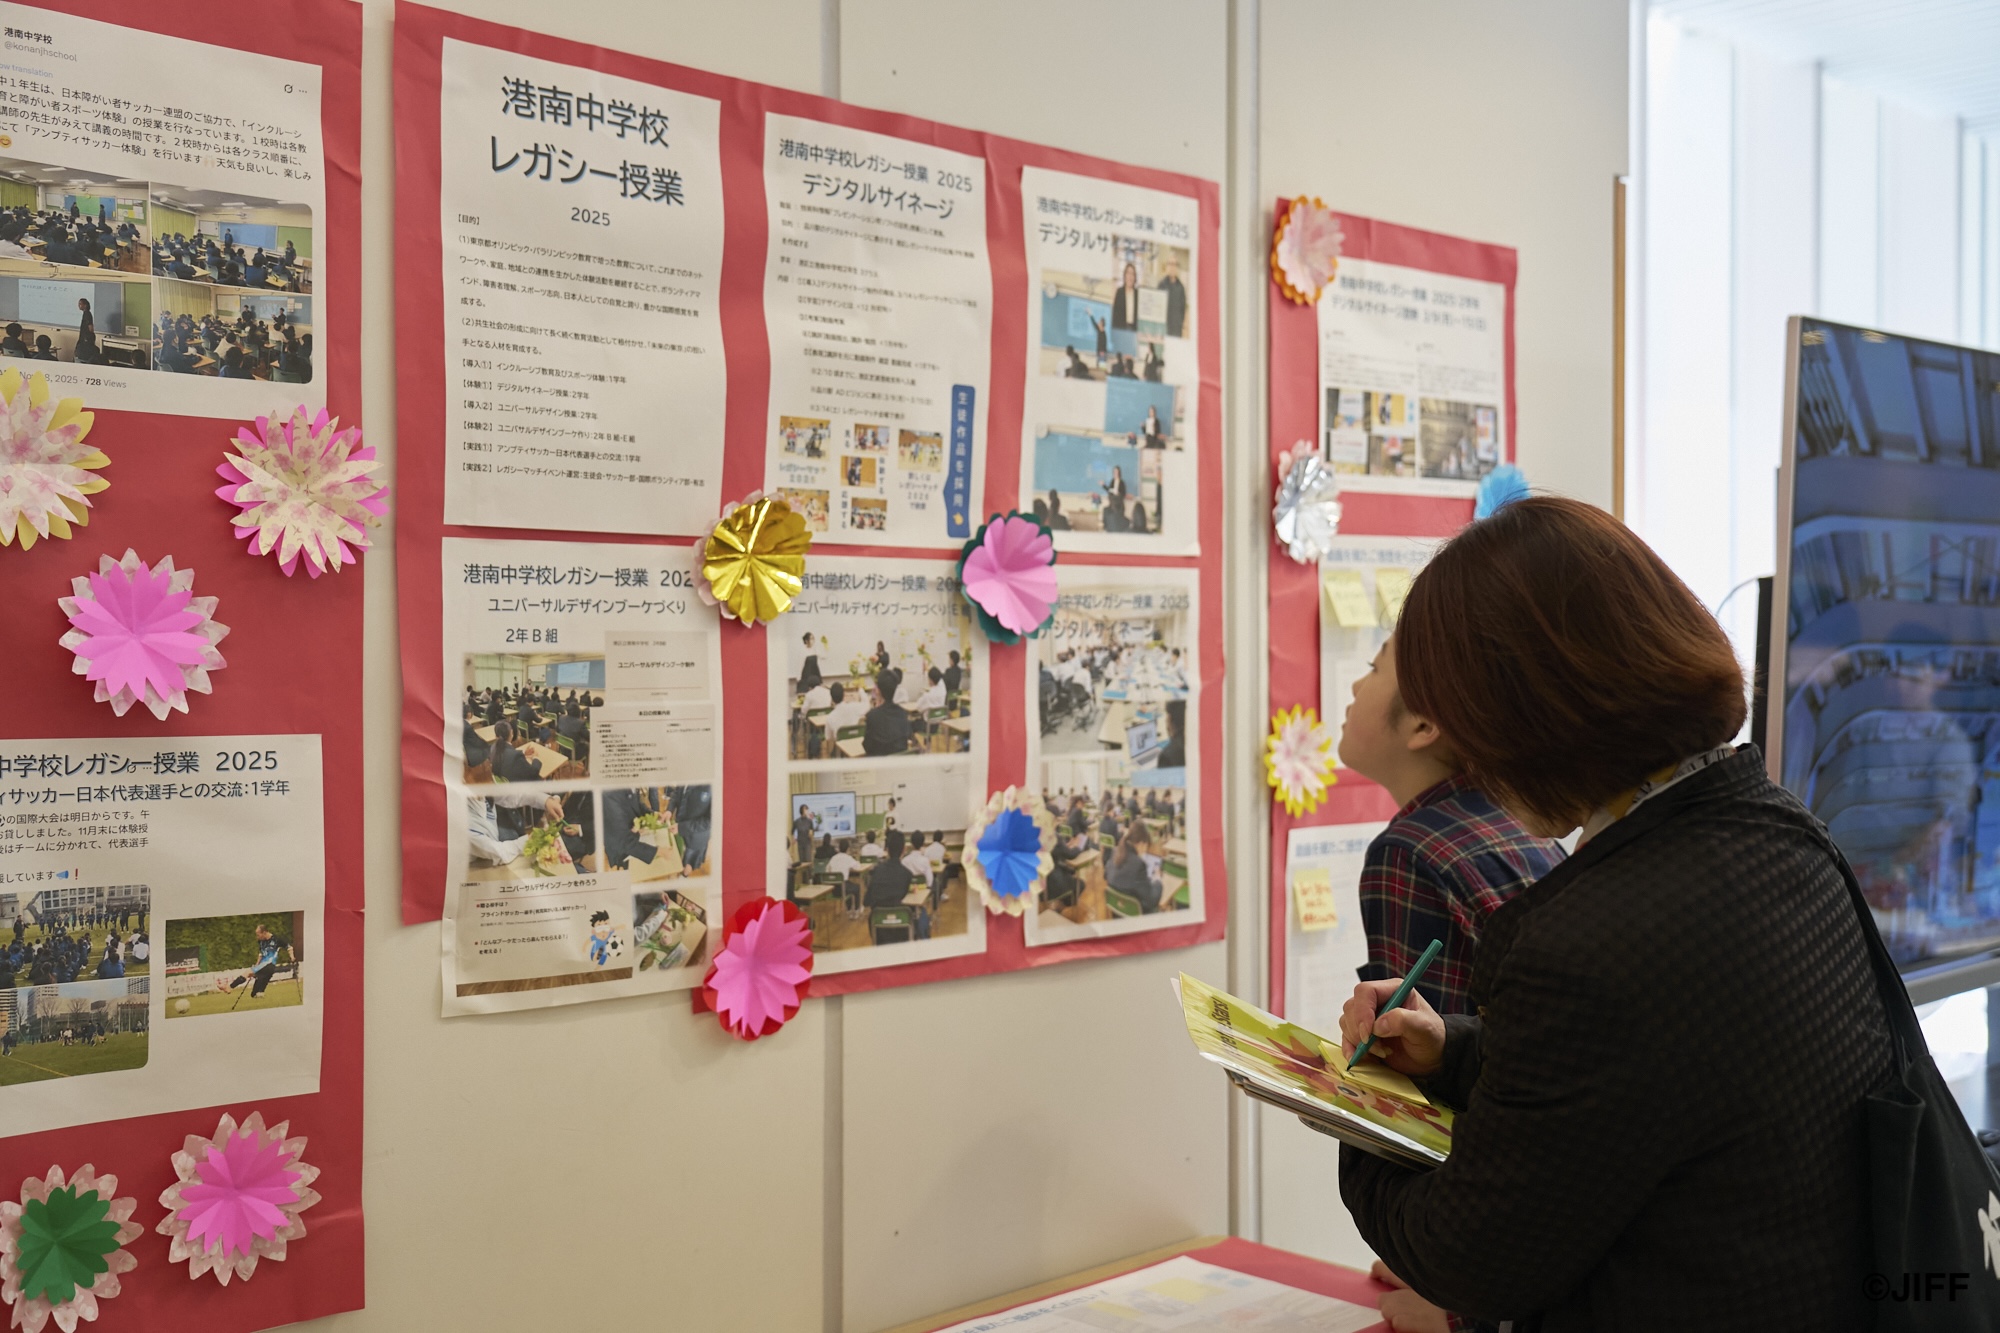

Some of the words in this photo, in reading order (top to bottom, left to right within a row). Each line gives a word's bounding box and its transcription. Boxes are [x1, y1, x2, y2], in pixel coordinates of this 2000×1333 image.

[4, 27, 53, 45] 港南中学校
[4, 40, 78, 62] @konanjhschool
[12, 64, 54, 78] translation
[501, 75, 670, 149] 港南中学校
[490, 135, 685, 207] レガシー授業
[779, 138, 929, 184] 港南中学校レガシー授業
[937, 170, 973, 193] 2025
[802, 173, 955, 220] デジタルサイネージ
[458, 213, 480, 225] 【目的】
[570, 207, 611, 226] 2025
[1037, 196, 1155, 232] 港南中学校レガシー授業
[461, 297, 486, 308] 成する。
[55, 375, 78, 385] 2025
[85, 377, 101, 386] 728
[103, 379, 127, 388] Views
[463, 563, 649, 588] 港南中学校レガシー授業
[660, 570, 694, 588] 202
[487, 598, 687, 615] ユニバーサルデザインブーケづくり
[1056, 593, 1153, 610] 中学校レガシー授業
[0, 750, 200, 779] 中学校レガシー授業
[215, 750, 278, 772] 2025
[499, 879, 598, 893] ユニバーサルデザインブーケを作ろう
